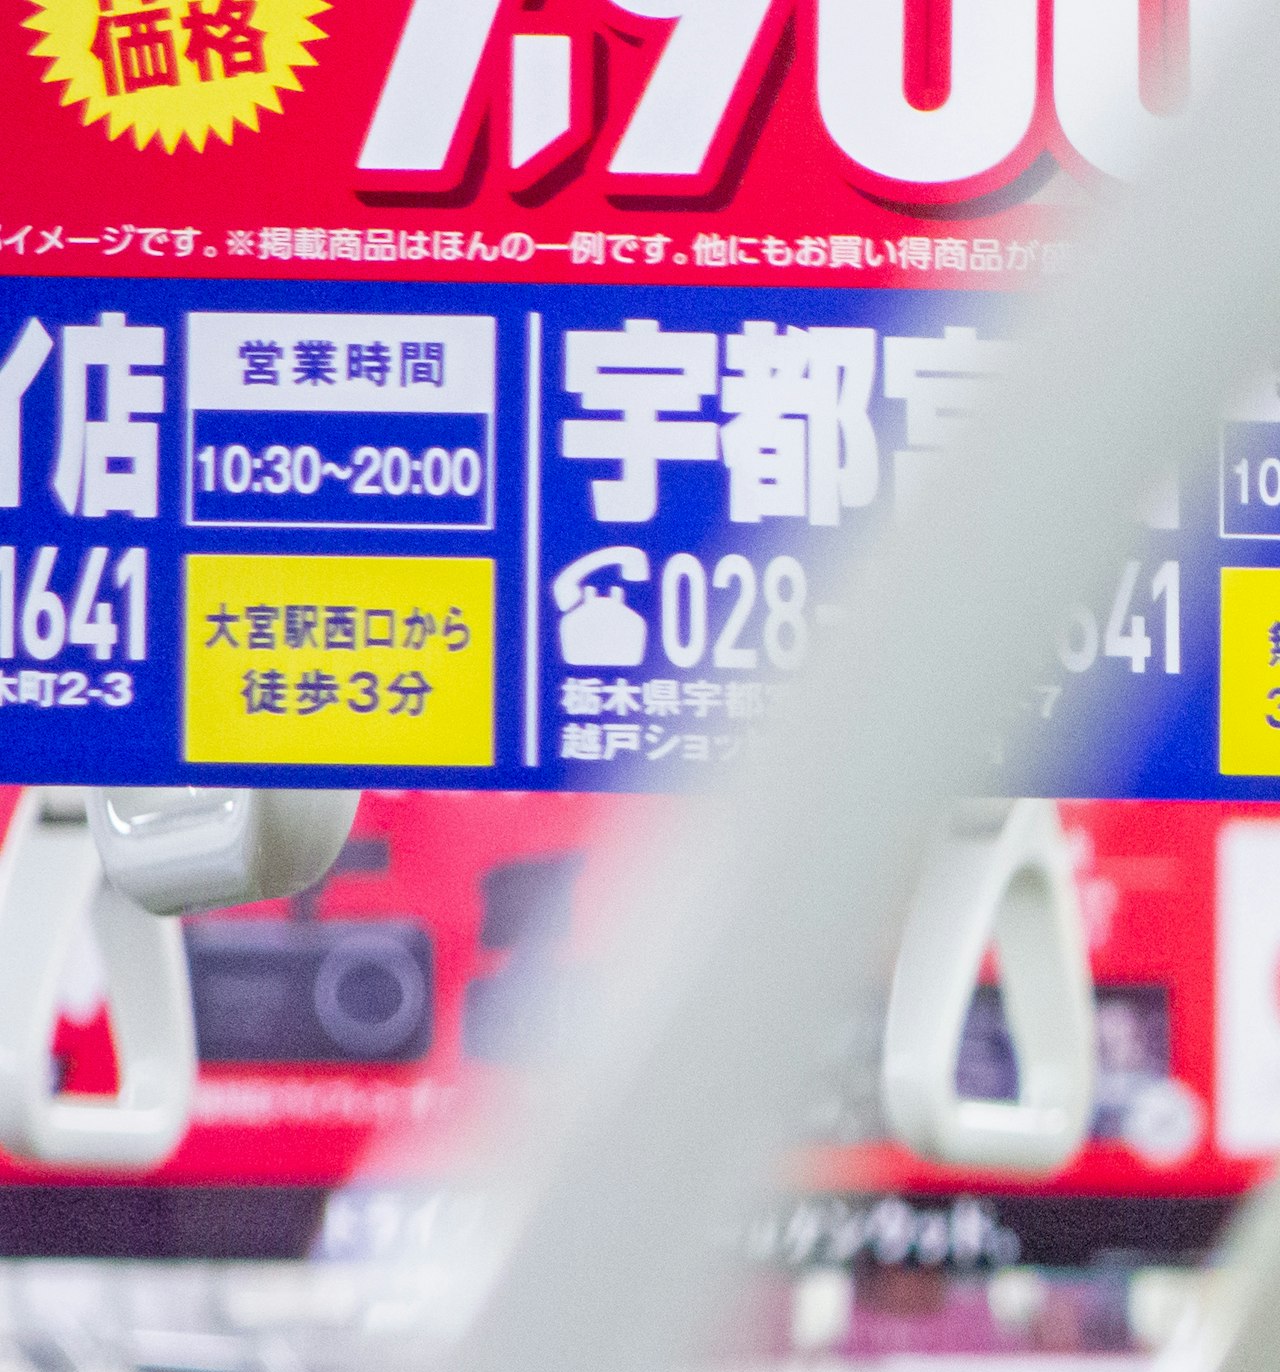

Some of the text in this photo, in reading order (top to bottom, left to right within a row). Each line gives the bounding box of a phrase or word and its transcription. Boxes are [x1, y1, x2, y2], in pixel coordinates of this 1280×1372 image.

[90, 0, 268, 97] 価格
[238, 340, 447, 388] 営業時間
[204, 602, 472, 653] 大宮駅西口から
[241, 668, 434, 717] 徒歩3分
